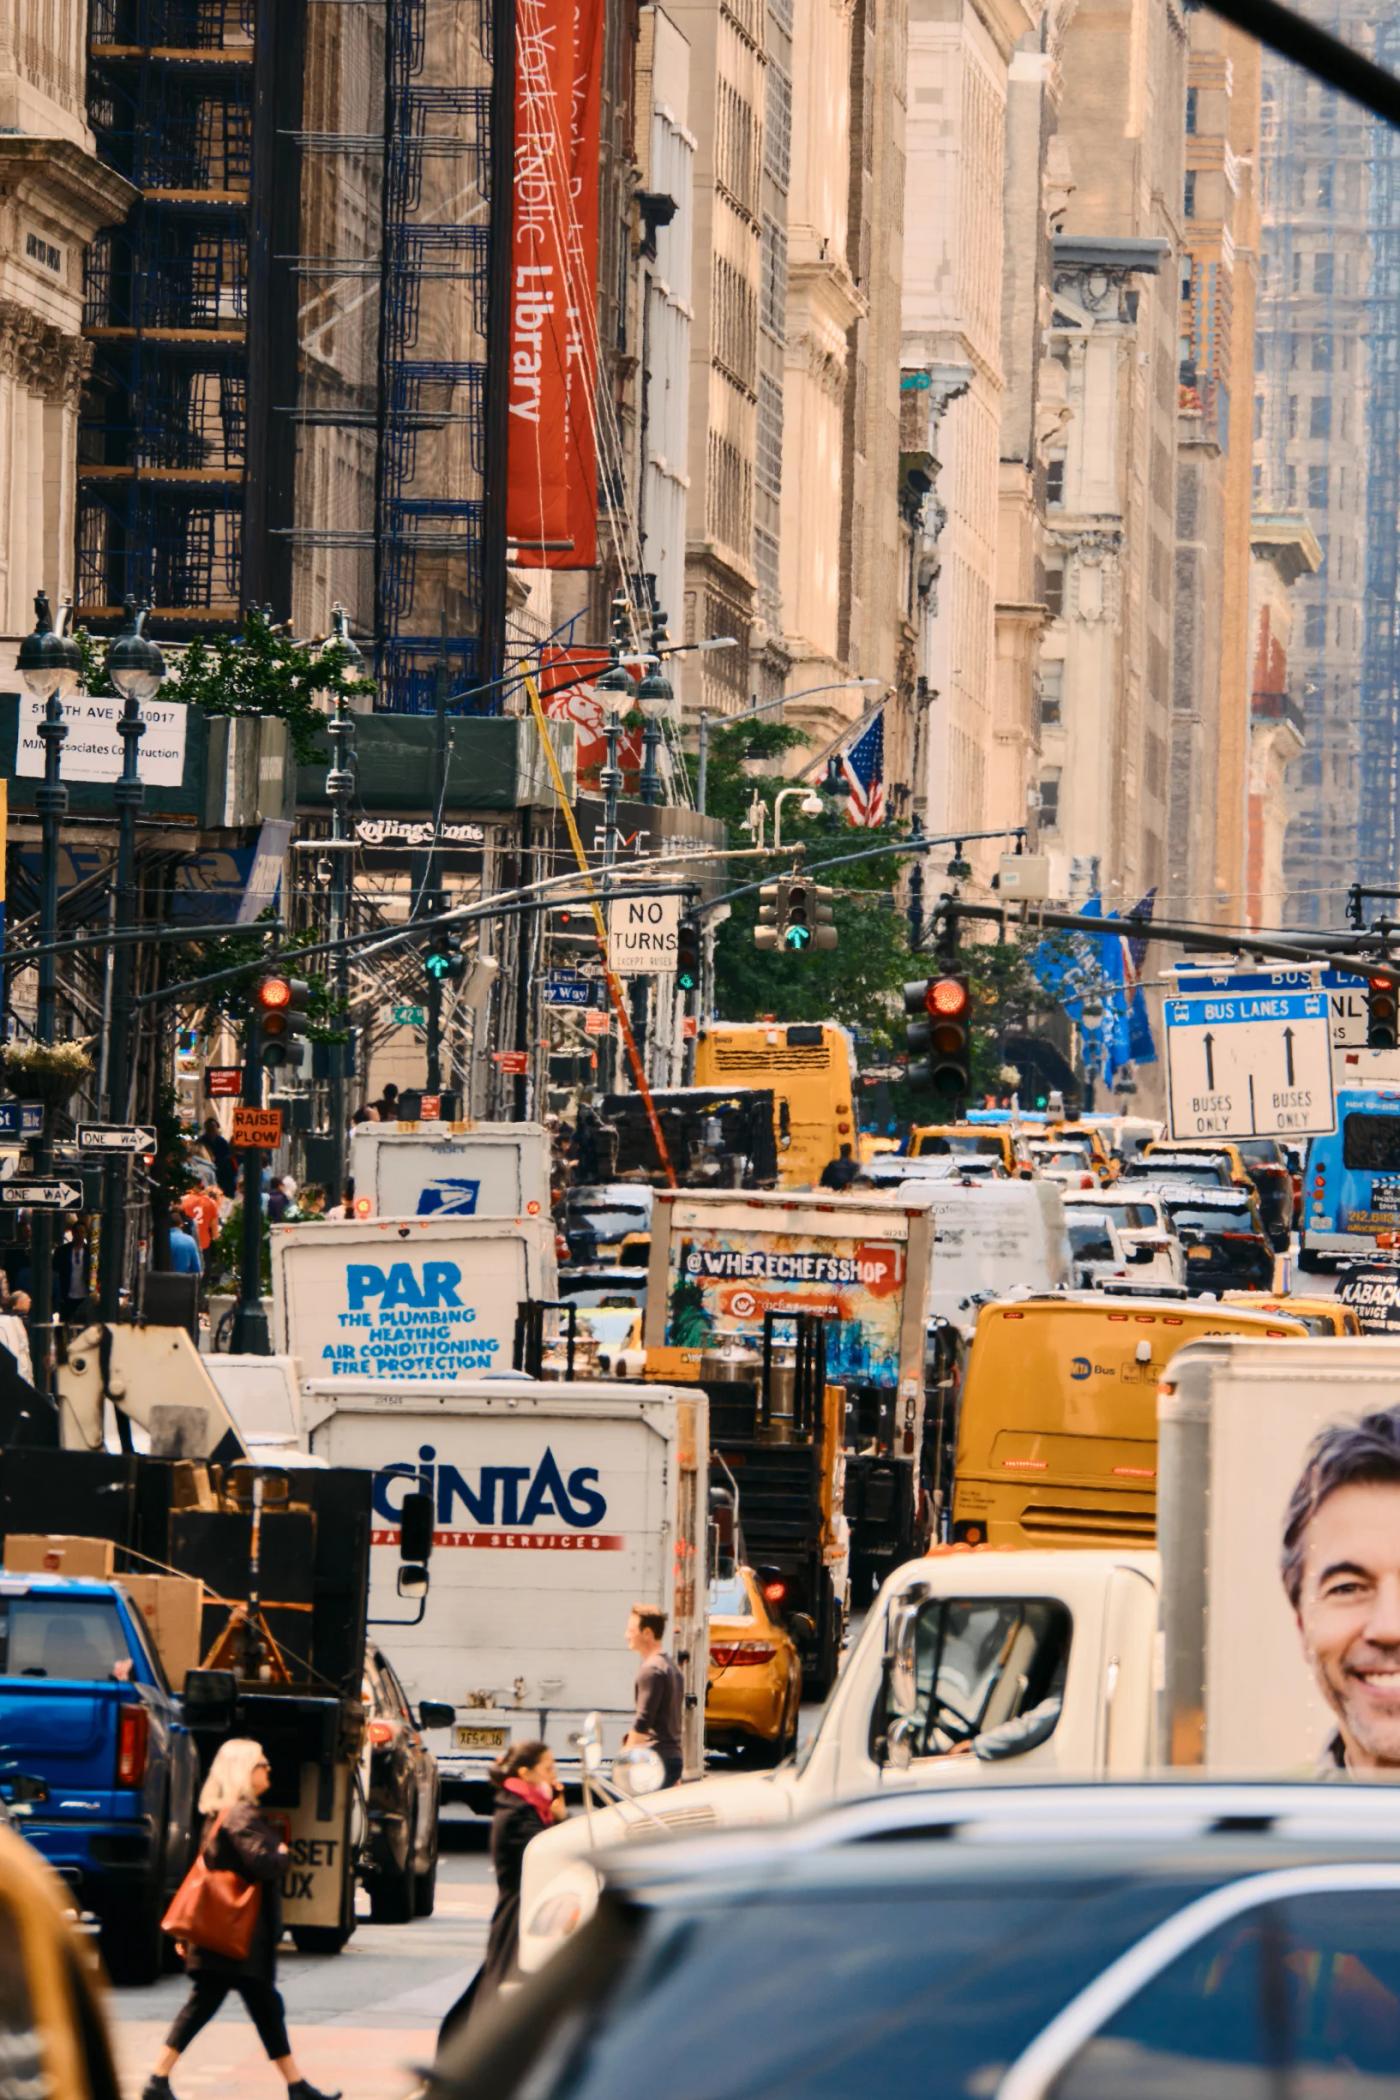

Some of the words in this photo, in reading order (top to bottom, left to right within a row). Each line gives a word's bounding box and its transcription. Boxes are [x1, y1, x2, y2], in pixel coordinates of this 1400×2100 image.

[519, 25, 557, 110] York
[515, 132, 557, 244] Public
[508, 265, 555, 423] Library
[31, 703, 47, 714] 51
[86, 706, 113, 719] AVE
[140, 711, 175, 723] 10017
[111, 745, 179, 759] Coruction
[628, 902, 663, 924] NO
[613, 932, 678, 951] TURNS
[559, 986, 586, 1003] Way
[1204, 1002, 1235, 1021] BUS
[1240, 999, 1290, 1018] LANES
[1192, 1096, 1232, 1113] BUSES
[1272, 1091, 1313, 1109] BUSES
[235, 1113, 279, 1126] RAISE
[1196, 1117, 1231, 1133] ONLY
[1276, 1112, 1309, 1129] ONLY
[84, 1133, 106, 1145] ONE
[120, 1134, 146, 1146] WAY
[235, 1130, 278, 1143] PLOW
[6, 1189, 30, 1200] ONE
[43, 1189, 71, 1201] WAY
[686, 1252, 888, 1284] @WHERECHEFSSHOP
[346, 1260, 466, 1310] PAR
[337, 1313, 373, 1328] THE
[379, 1308, 476, 1327] PLUMBING
[368, 1325, 452, 1343] HEATING
[322, 1344, 356, 1359] AIR
[360, 1338, 500, 1358] CONDITIONING
[332, 1359, 371, 1375] FIRE
[376, 1354, 492, 1373] PROTECTION
[1094, 1365, 1116, 1375] Bus
[372, 1531, 476, 1546] FAITY
[490, 1535, 601, 1549] SERVICES
